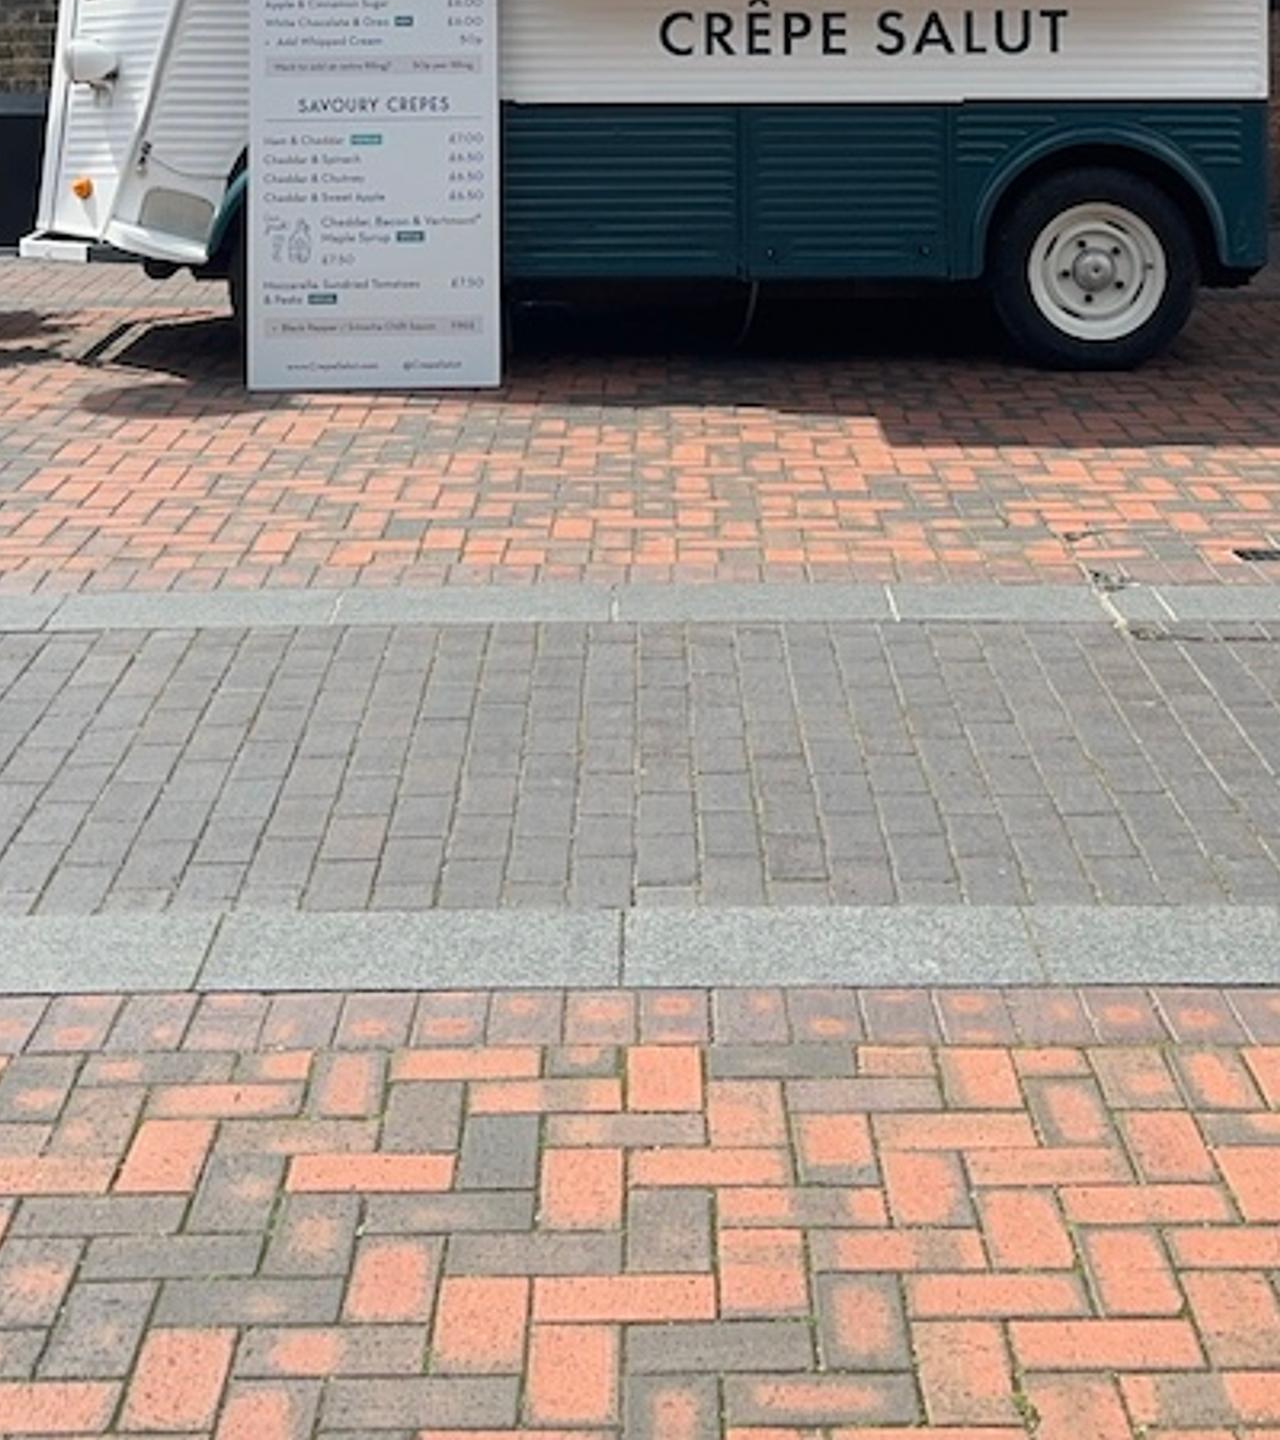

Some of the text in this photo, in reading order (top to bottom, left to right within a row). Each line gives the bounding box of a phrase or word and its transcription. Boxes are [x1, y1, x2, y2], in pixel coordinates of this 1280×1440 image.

[265, 0, 295, 11] Apple
[297, 0, 305, 9] &
[265, 17, 295, 27] White
[297, 16, 349, 27] Chocolate
[353, 17, 360, 27] &
[875, 9, 1069, 56] SALUT
[277, 36, 298, 46] Add
[301, 35, 346, 48] Whipped
[349, 34, 382, 46] Cream
[297, 97, 379, 113] SAVOURY
[290, 134, 297, 145] &
[300, 133, 345, 146] Cheddar
[263, 153, 361, 167] Cheddar & Spinach
[263, 172, 365, 185] Cheddar & Chutney
[263, 191, 385, 205] Cheddar & Sweet Apple
[375, 215, 409, 227] Bacon
[413, 215, 420, 225] &
[323, 278, 369, 289] Sundried
[371, 278, 421, 289] Tomatoes
[264, 295, 271, 305] &
